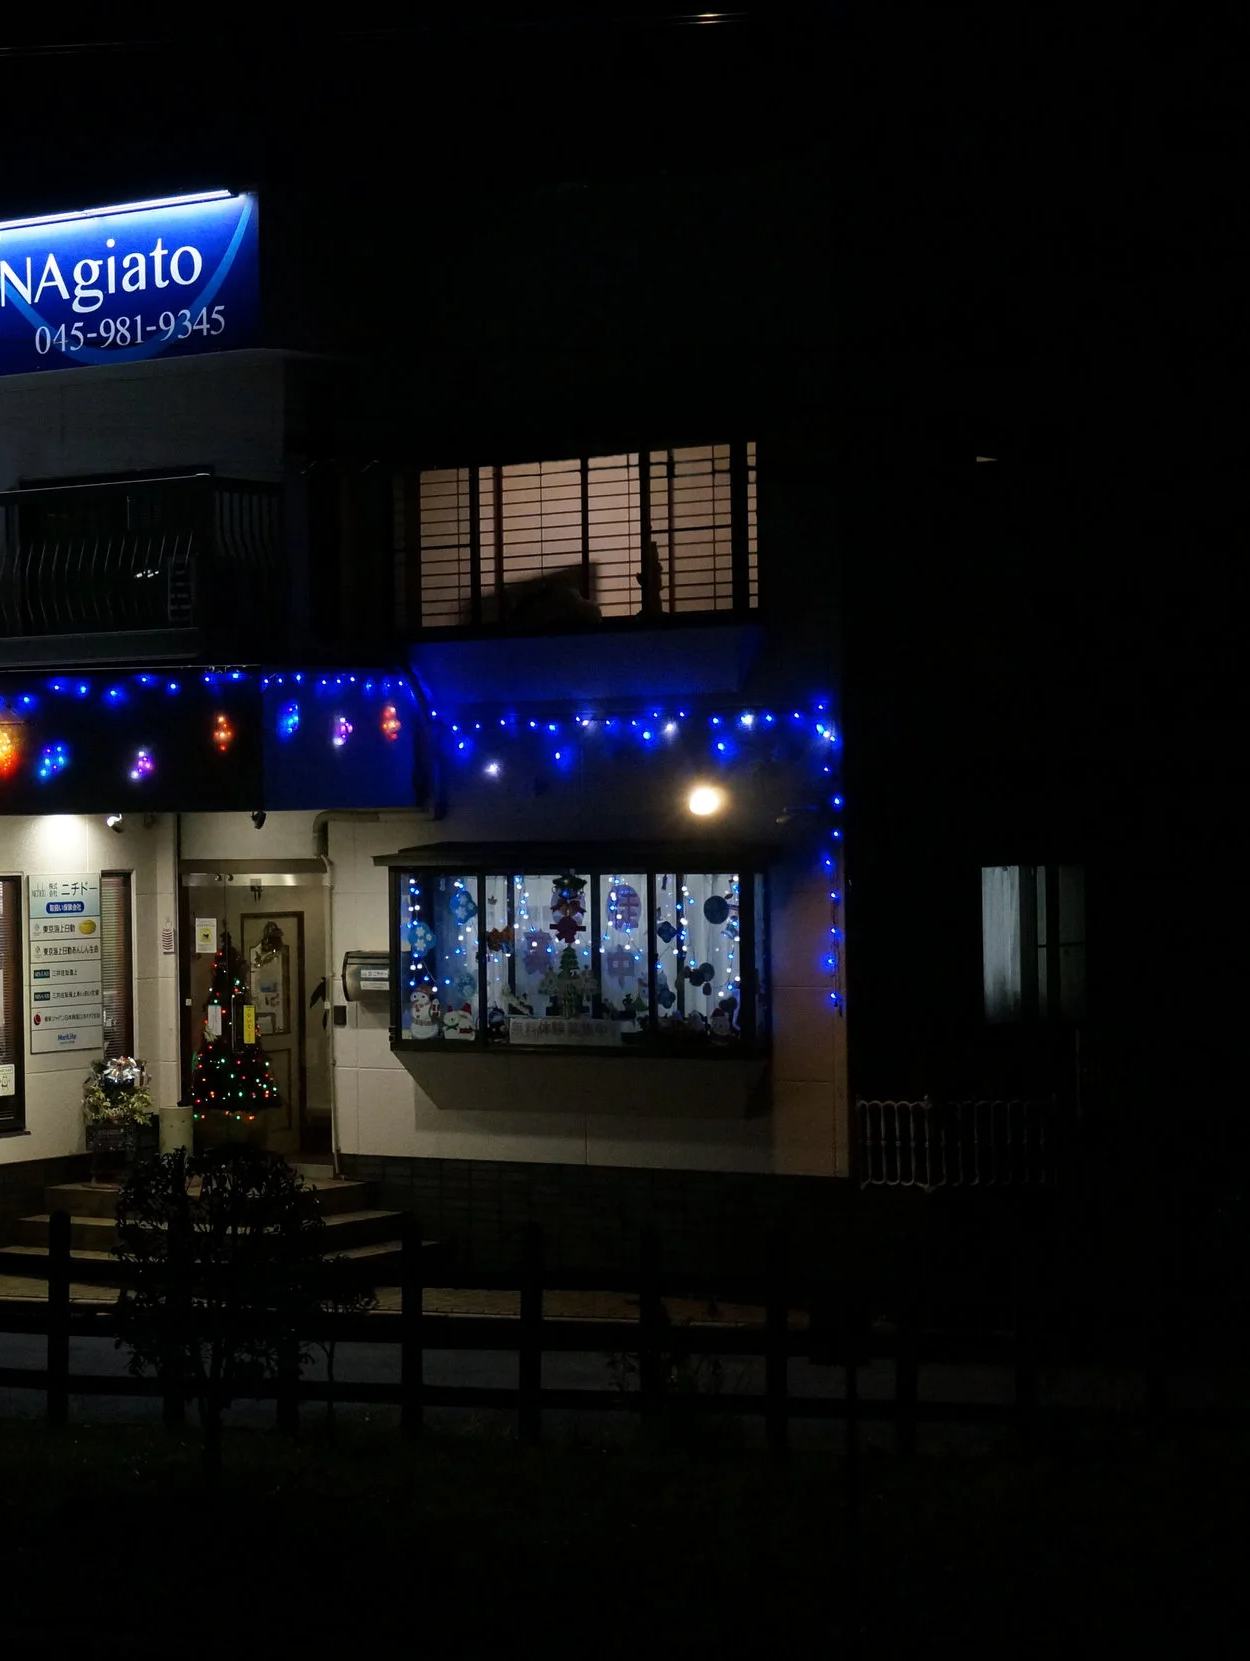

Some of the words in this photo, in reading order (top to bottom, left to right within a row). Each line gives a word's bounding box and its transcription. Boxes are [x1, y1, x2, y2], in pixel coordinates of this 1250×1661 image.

[34, 304, 227, 355] 045-981-9345
[61, 882, 98, 896] ニチドー
[43, 924, 75, 934] 東京海上日動
